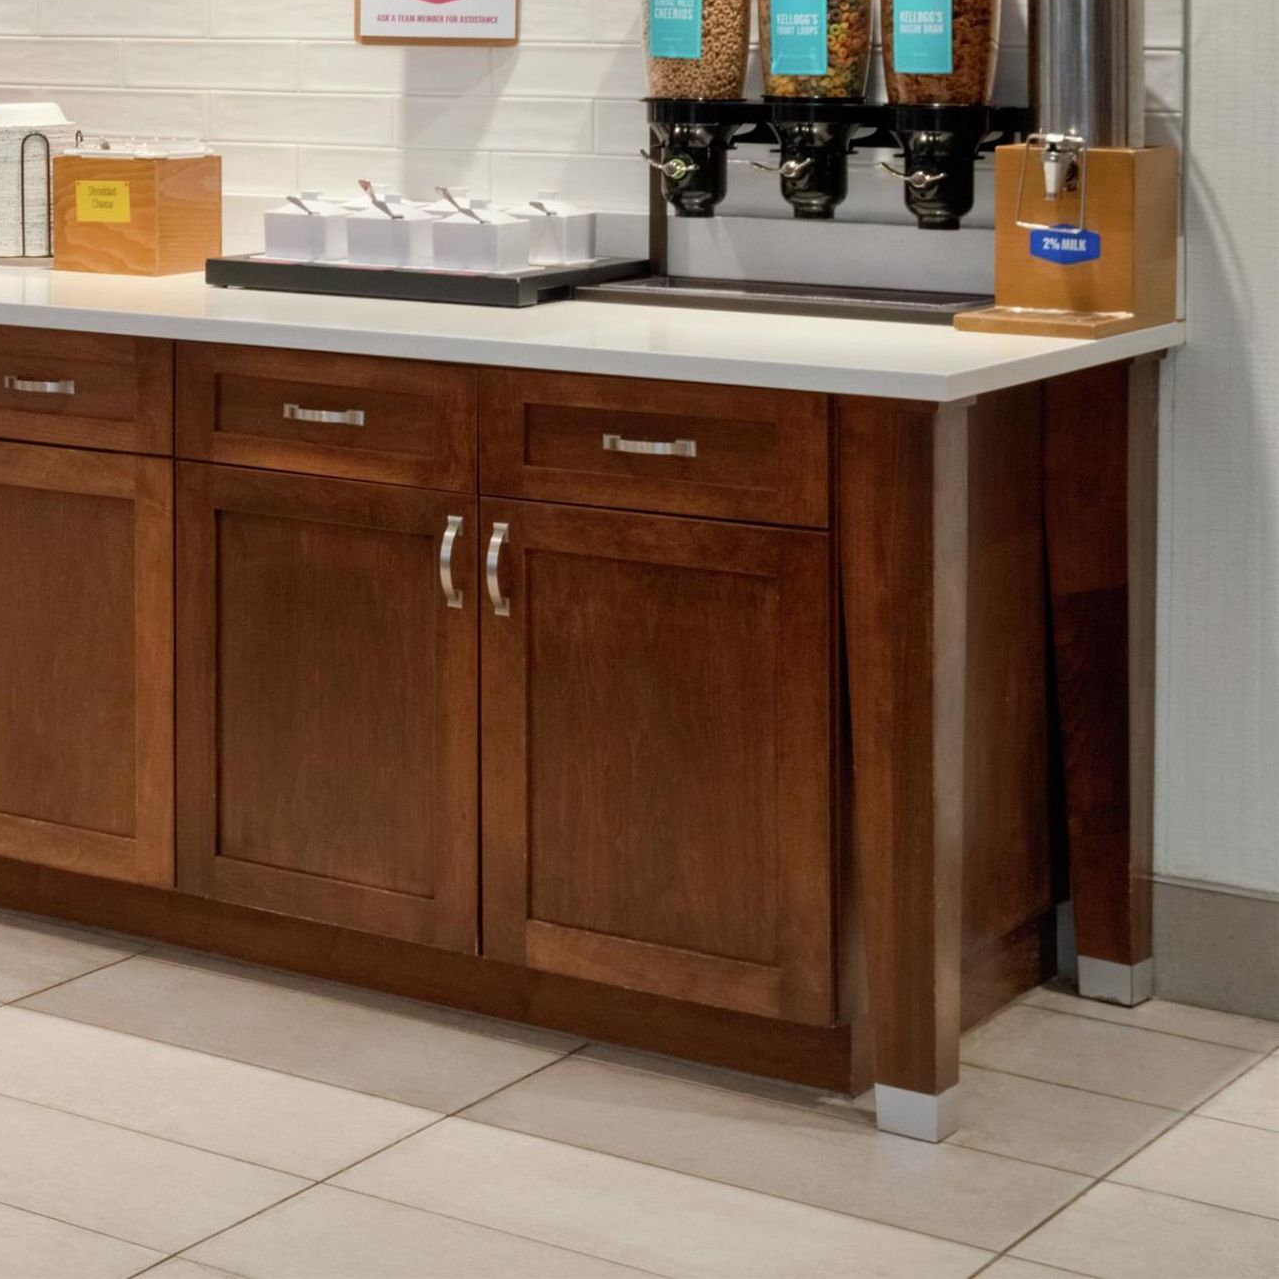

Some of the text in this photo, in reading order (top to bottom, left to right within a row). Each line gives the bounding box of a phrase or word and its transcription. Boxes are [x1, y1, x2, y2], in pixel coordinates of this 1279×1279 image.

[377, 14, 389, 22] ASK
[398, 14, 415, 22] TEAM
[417, 15, 444, 23] MEMBER
[445, 15, 458, 23] FOR
[654, 8, 693, 21] CHEERIOS
[776, 13, 819, 26] KELLOGG'S
[899, 10, 943, 23] KELLOGG'S
[797, 26, 819, 36] LOOPS
[88, 186, 117, 197] Shredded
[1042, 237, 1087, 252] 2% MILK
